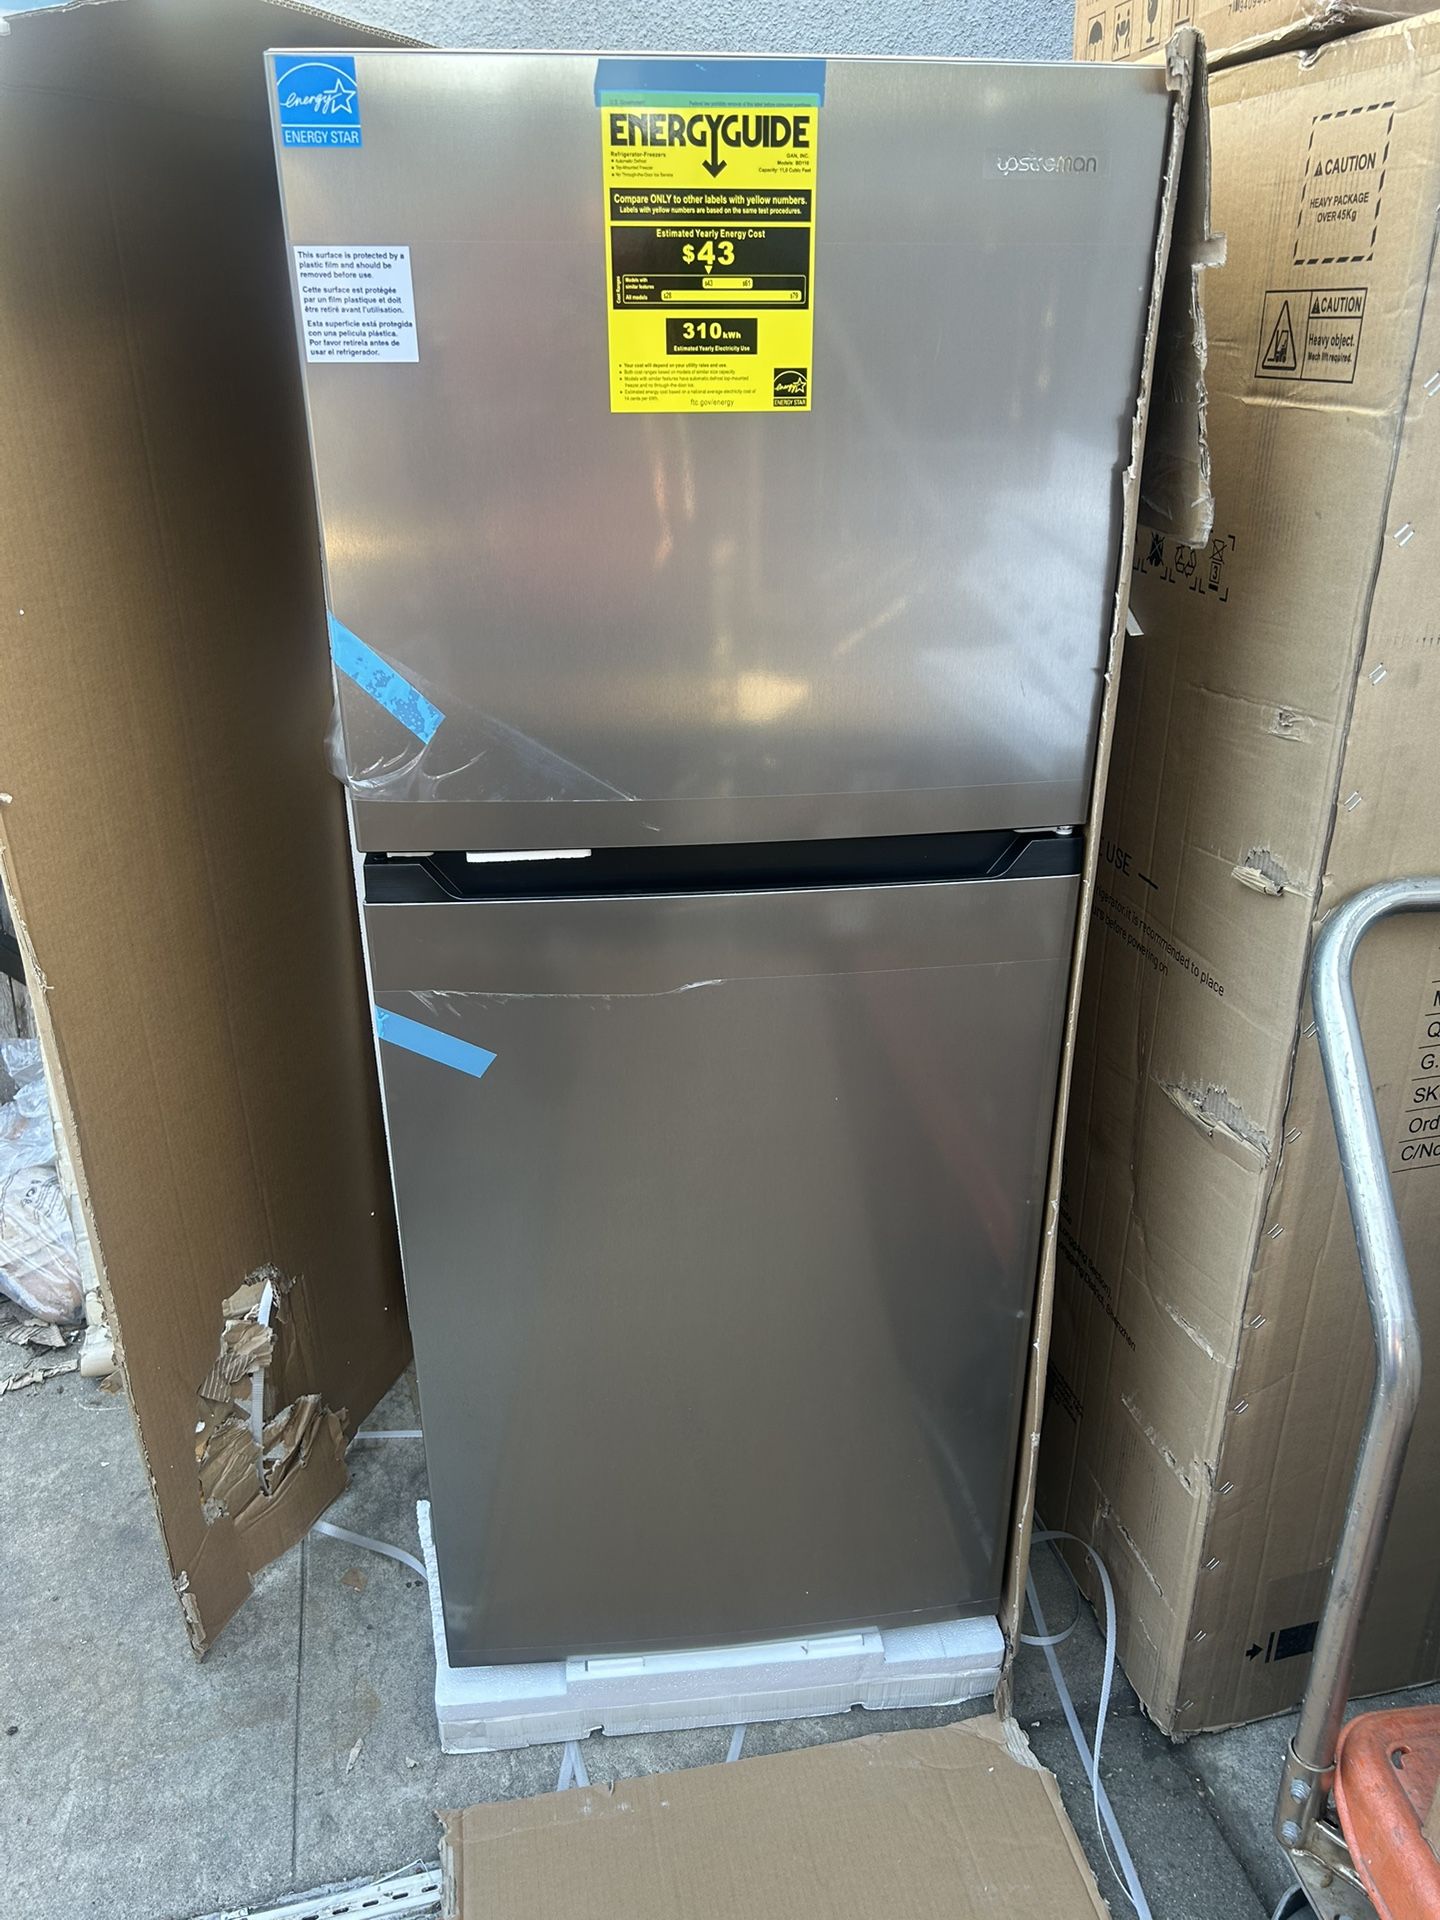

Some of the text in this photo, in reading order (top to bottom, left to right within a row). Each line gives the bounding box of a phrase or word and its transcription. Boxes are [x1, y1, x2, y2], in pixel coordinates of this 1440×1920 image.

[281, 92, 337, 114] energy
[285, 130, 360, 144] ENERGY STAR
[610, 113, 811, 148] ENERGYGUIDE
[1324, 152, 1376, 175] CAUTION
[614, 194, 807, 206] Compare ONLY to other labels with yellow numbers.
[1309, 191, 1370, 208] HEAVY PACKAGE
[620, 206, 638, 214] Labels
[639, 206, 651, 214] with
[652, 206, 670, 215] yellow
[770, 207, 802, 215] procedures.
[1317, 211, 1337, 223] OVER
[656, 229, 765, 240] Estimated Yearly Energy Cost
[298, 251, 314, 259] This
[316, 251, 343, 259] surface
[345, 251, 351, 259] is
[353, 252, 387, 261] protected
[389, 252, 398, 261] by
[682, 240, 735, 266] $43
[299, 262, 323, 270] plastic
[302, 286, 321, 294] Cette
[323, 286, 350, 294] surface
[365, 287, 396, 295] protégée
[344, 296, 377, 304] plastique
[1320, 297, 1362, 313] CAUTION
[325, 320, 360, 328] superficie
[379, 321, 413, 329] protegida
[682, 322, 741, 339] 310 kWh
[1308, 333, 1355, 349] Heavy object.
[336, 349, 380, 357] refrigerador.
[1328, 353, 1352, 363] required.
[1106, 841, 1132, 877] USE
[1105, 917, 1127, 941] before
[1127, 933, 1159, 970] powering
[1159, 964, 1168, 976] on
[1139, 920, 1190, 969] recommended
[1191, 962, 1200, 977] to
[1200, 971, 1224, 997] place
